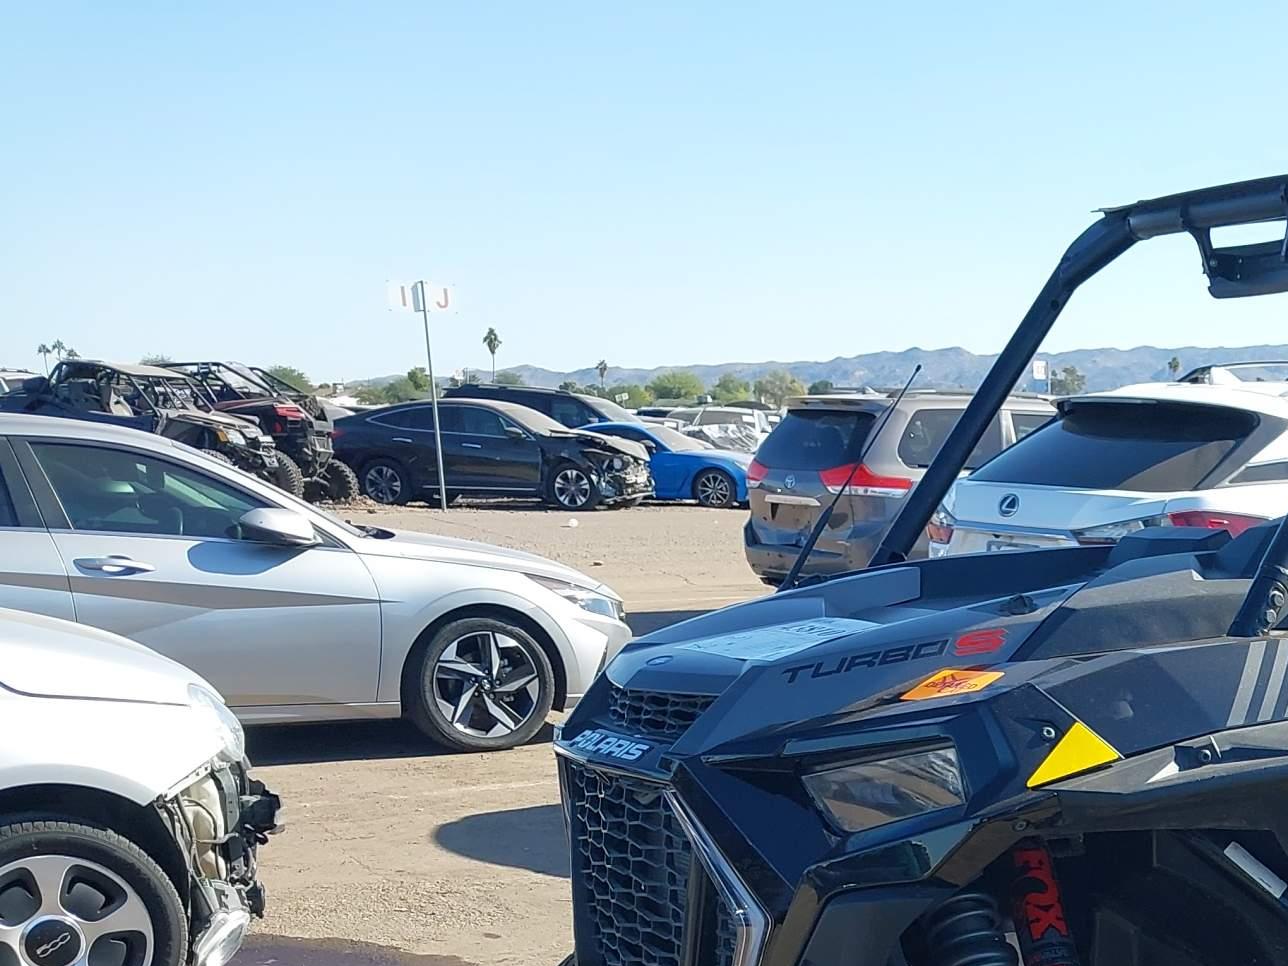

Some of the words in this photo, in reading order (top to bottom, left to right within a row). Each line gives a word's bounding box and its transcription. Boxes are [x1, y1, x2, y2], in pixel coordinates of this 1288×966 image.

[436, 287, 449, 309] J
[782, 638, 951, 685] TURBO
[955, 627, 1009, 657] S
[569, 728, 651, 761] POLARIS
[1014, 847, 1069, 941] FOX
